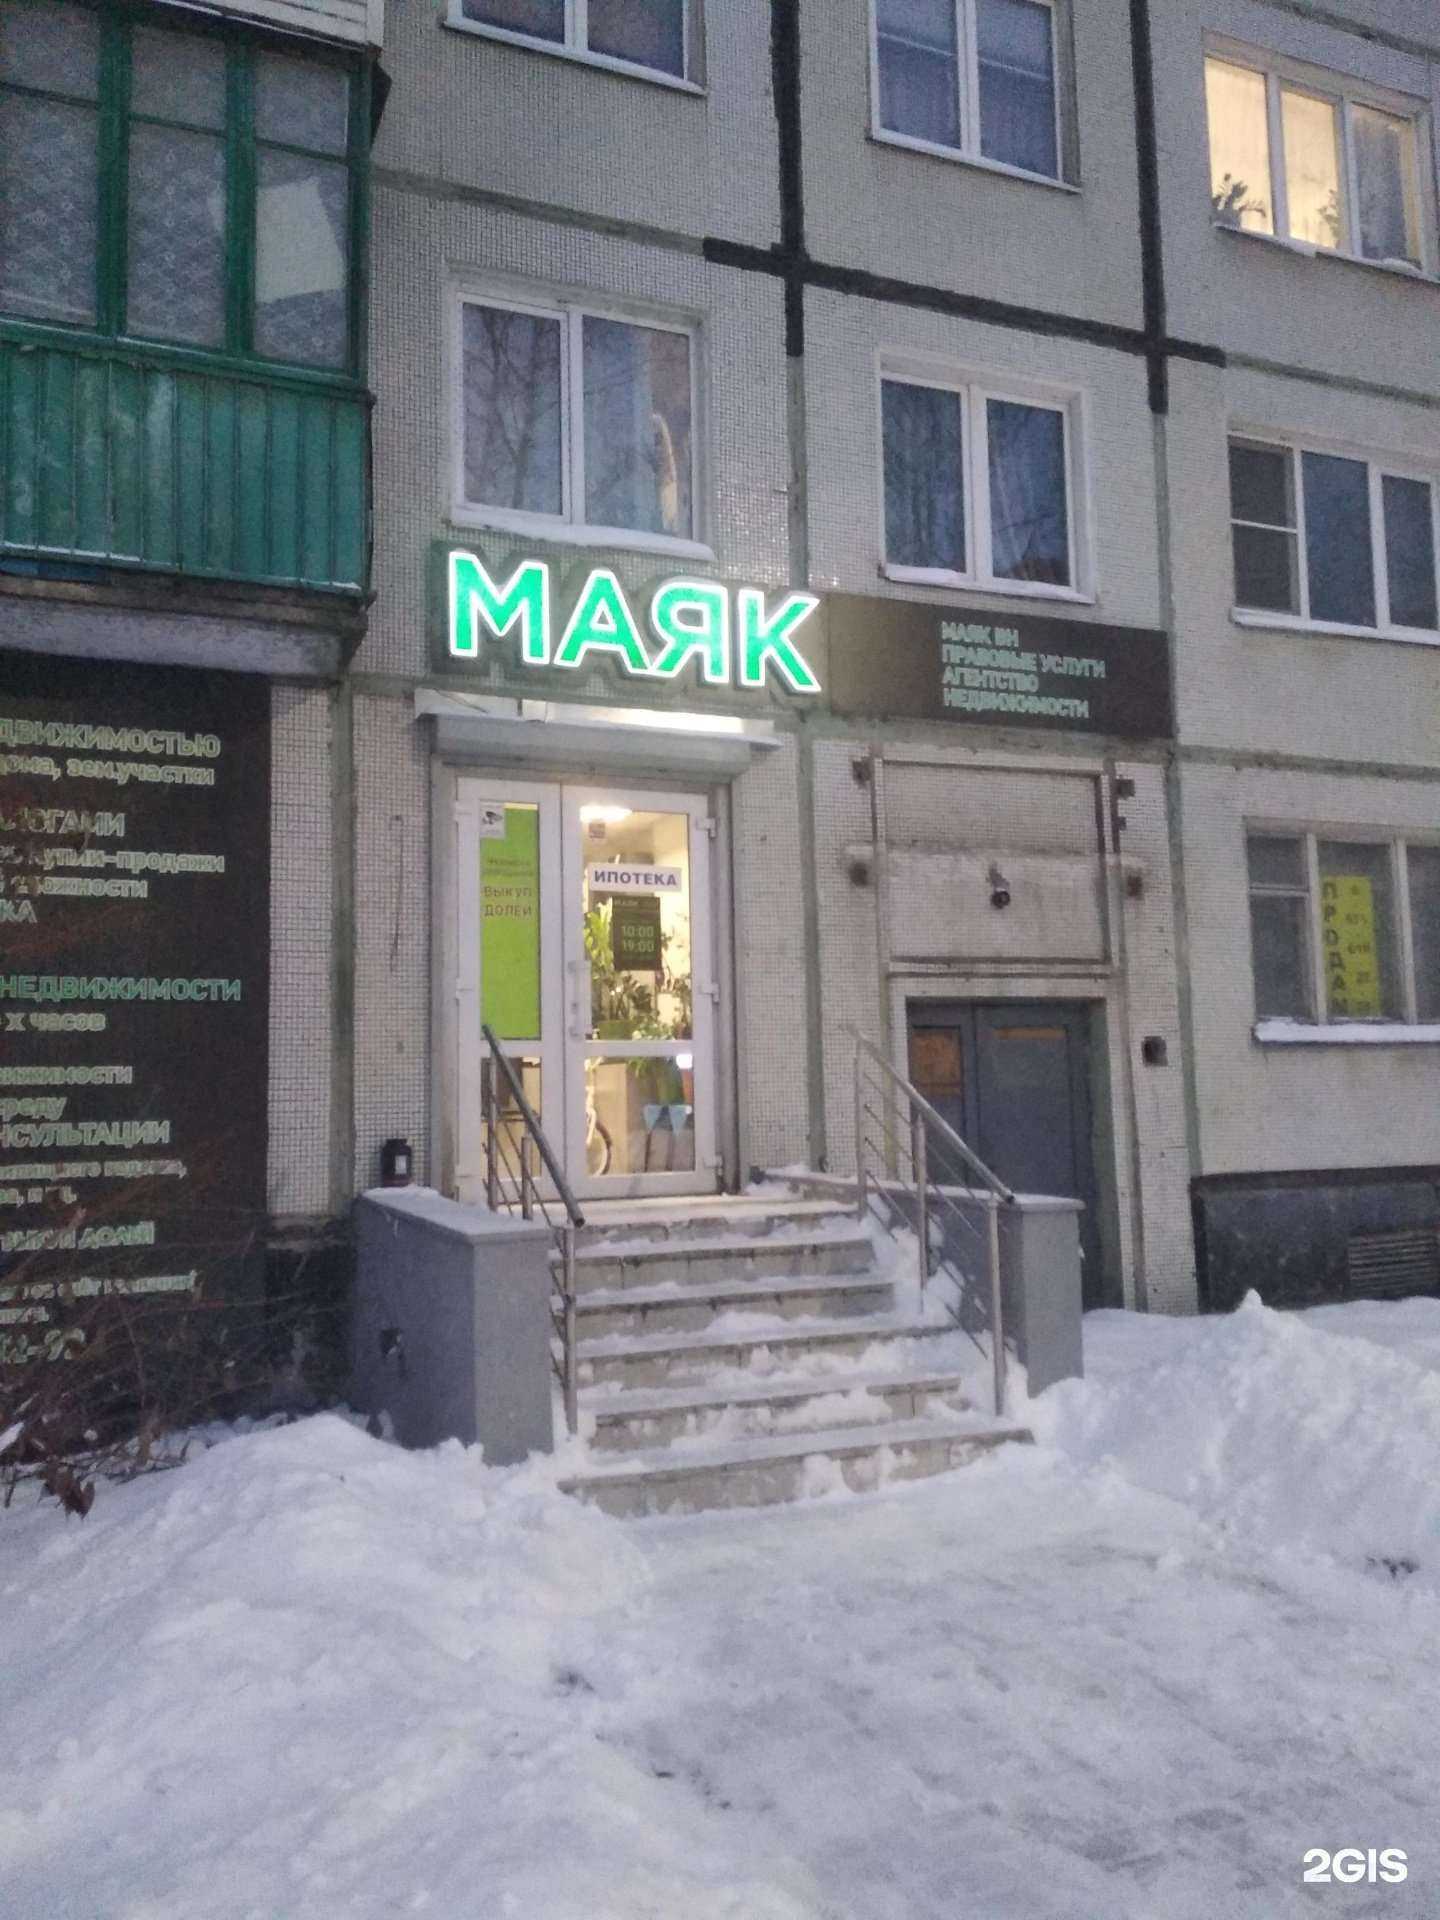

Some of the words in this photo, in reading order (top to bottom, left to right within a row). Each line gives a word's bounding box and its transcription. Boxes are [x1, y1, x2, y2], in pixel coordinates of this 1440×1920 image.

[449, 551, 822, 693] МАЯК
[941, 620, 991, 645] МАЯК
[942, 643, 1037, 671] ПРАВОВЫЕ
[1039, 653, 1106, 678] УСЛУГИ
[942, 665, 1039, 692] АГЕНТСТВО
[943, 687, 1089, 719] НЕДВИЖИМОСТИ
[594, 870, 677, 886] ИПОТЕКА
[0, 975, 241, 1002] НЕДВИЖИМОСТИ
[29, 1012, 106, 1032] часов
